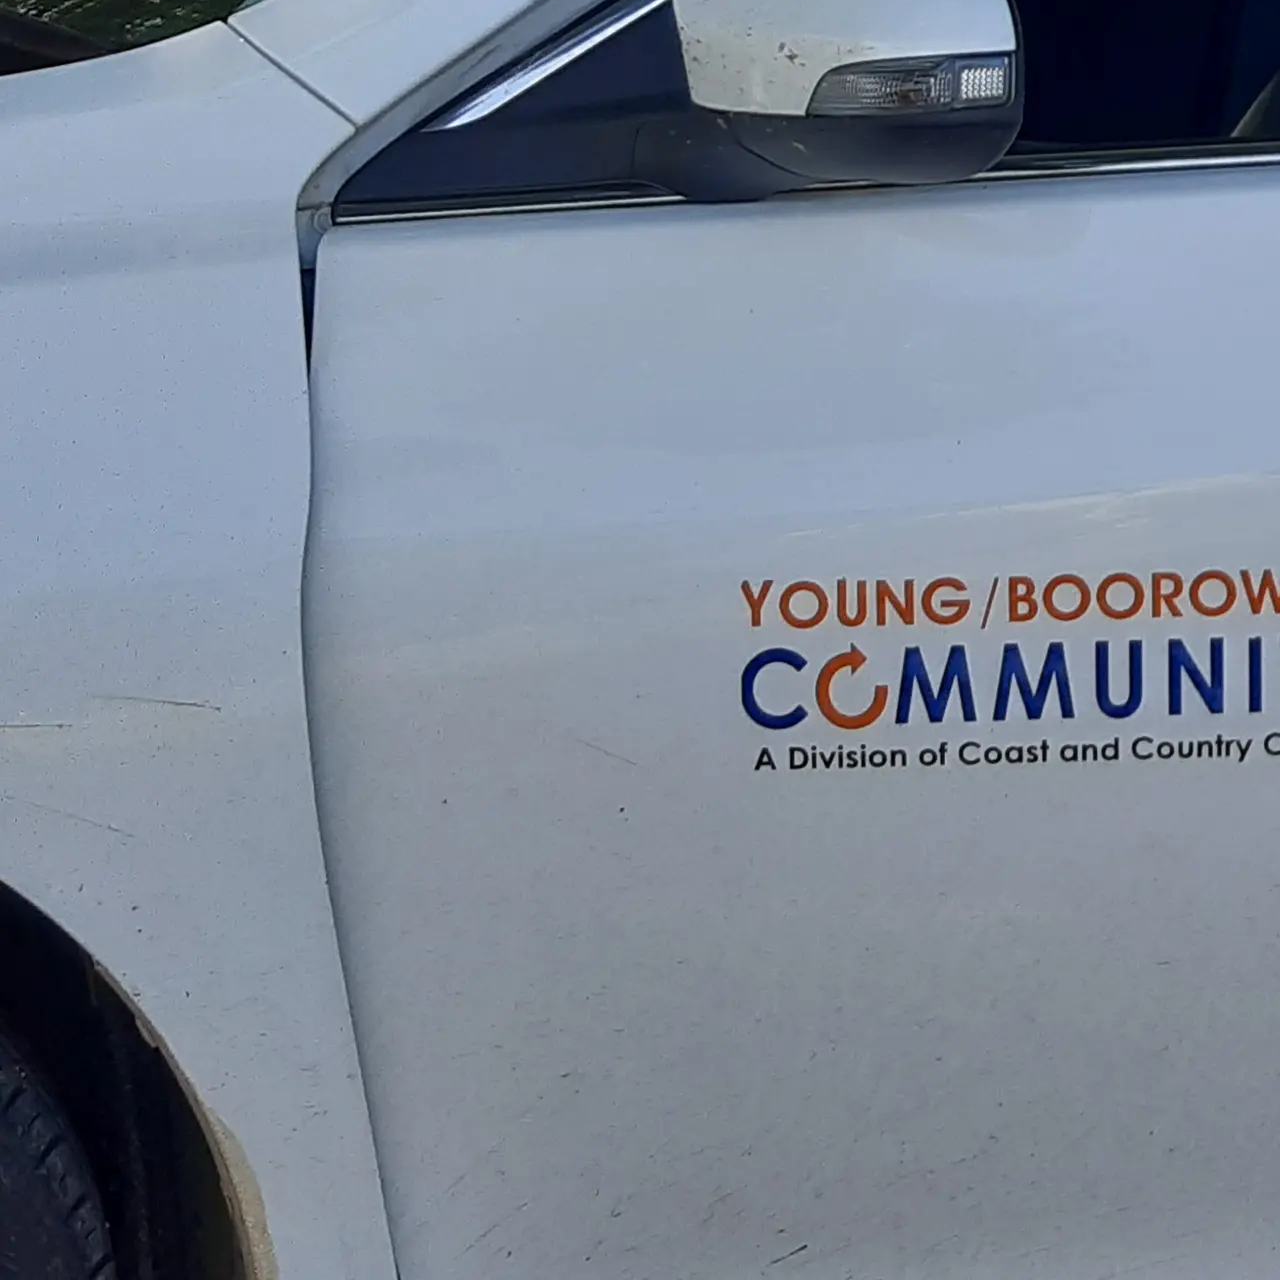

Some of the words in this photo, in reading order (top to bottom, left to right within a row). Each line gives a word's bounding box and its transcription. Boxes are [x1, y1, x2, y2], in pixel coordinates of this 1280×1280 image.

[754, 747, 777, 772] A
[788, 743, 907, 771] Division
[918, 741, 949, 767] of
[958, 739, 1050, 766] Coast
[1059, 736, 1120, 763] and
[1131, 734, 1253, 763] Country
